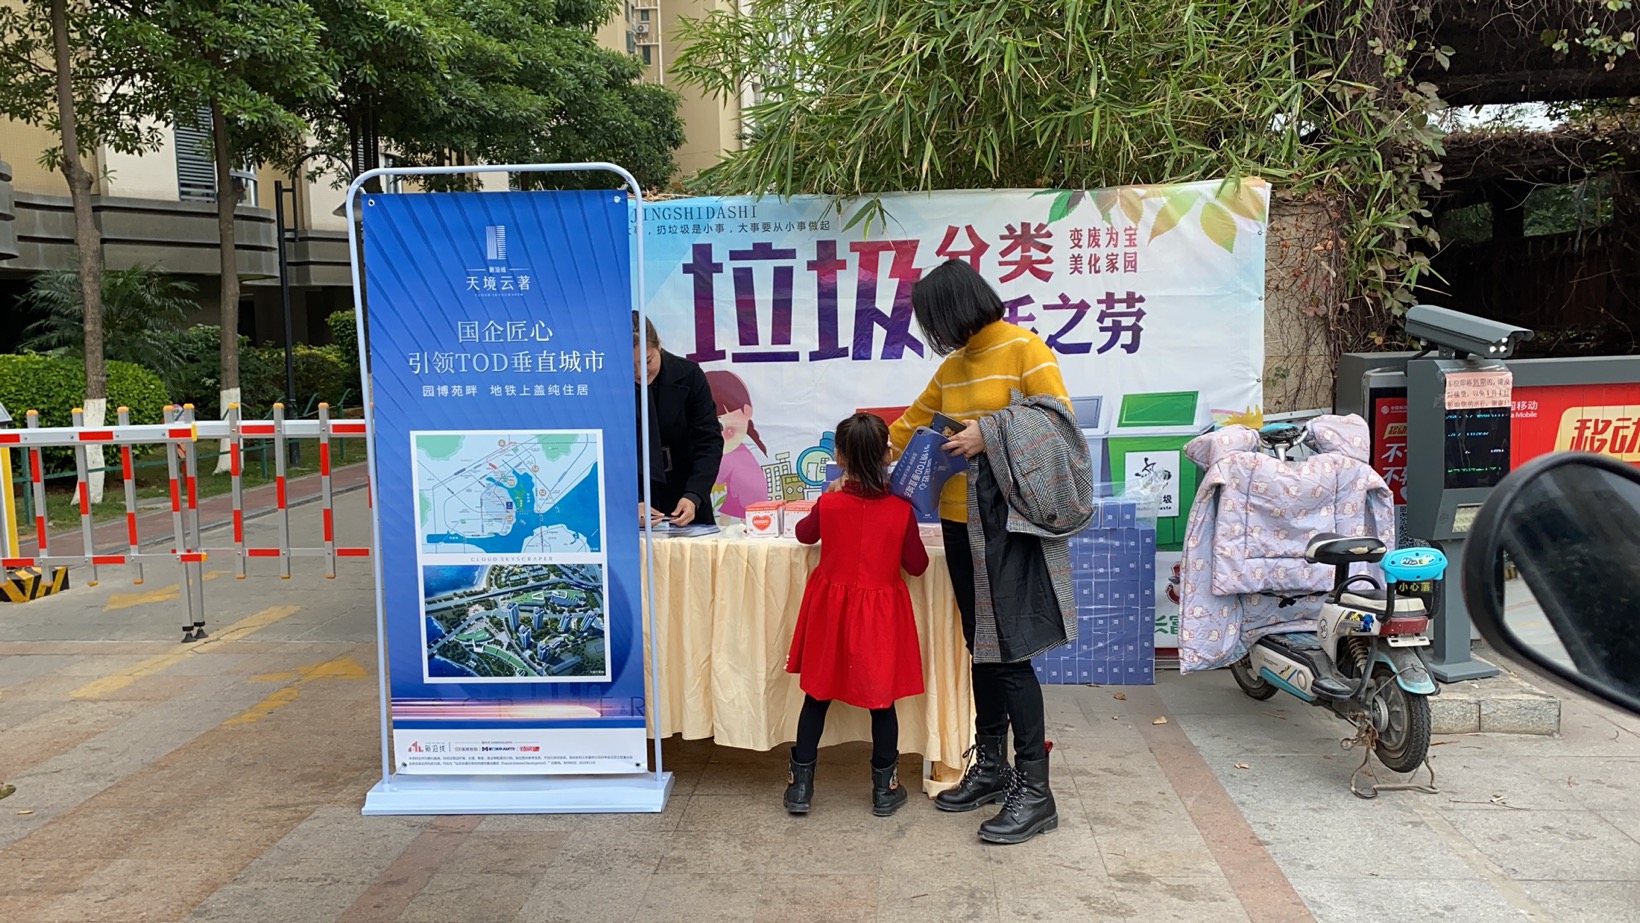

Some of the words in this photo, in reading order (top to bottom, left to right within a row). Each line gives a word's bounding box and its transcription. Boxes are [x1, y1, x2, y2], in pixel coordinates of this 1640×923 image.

[1069, 226, 1138, 250] 变废为宝
[1069, 252, 1138, 275] 美化家园
[466, 275, 531, 291] 天境云著
[457, 319, 553, 343] 国企匠心
[408, 350, 606, 375] 引领TOD垂直城市
[422, 385, 478, 397] 园博苑畔
[490, 384, 589, 396] 地铁上盖纯住居
[1381, 443, 1407, 462] 不
